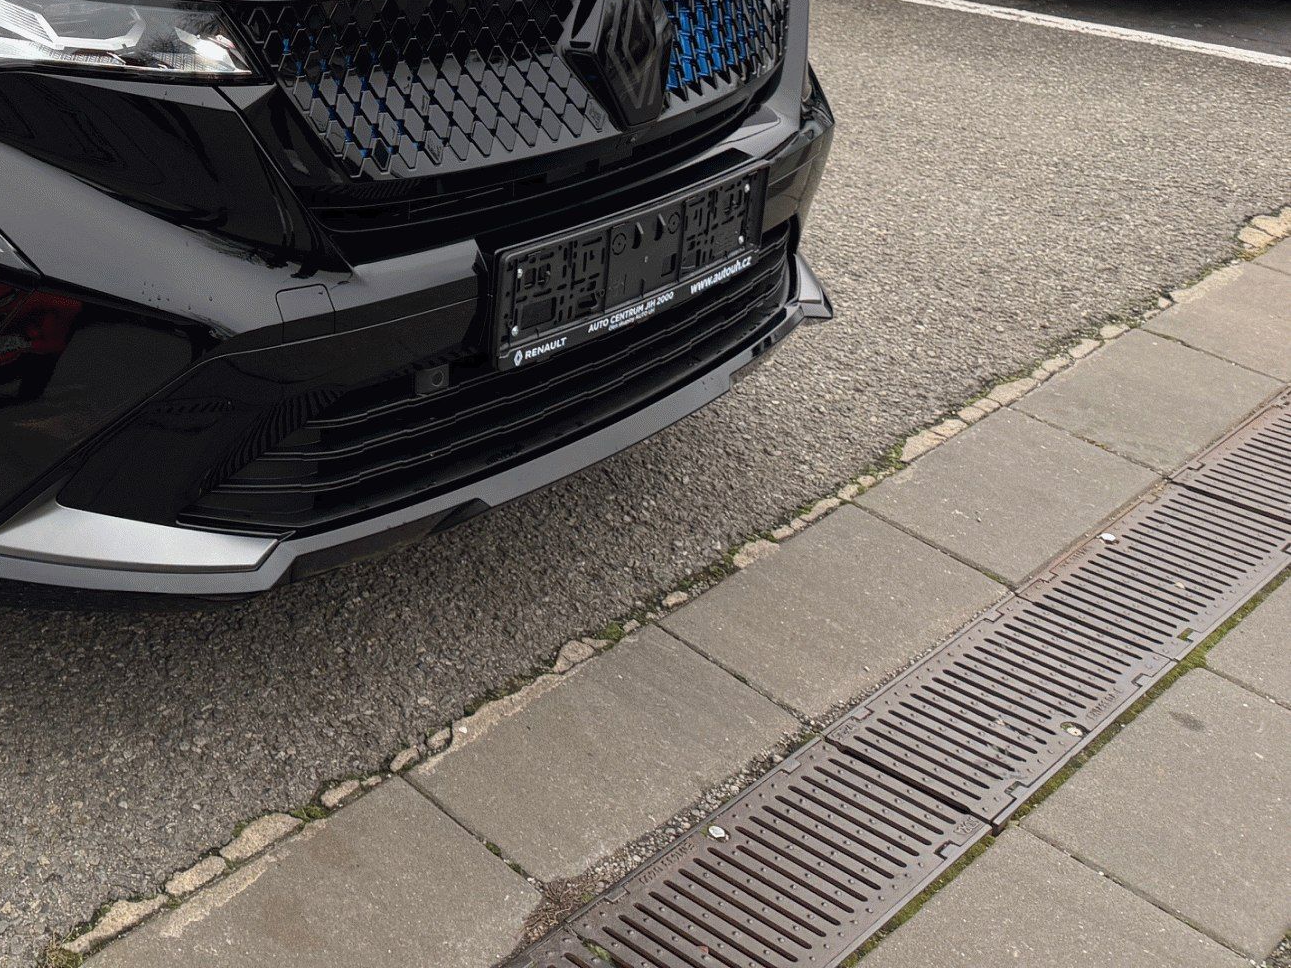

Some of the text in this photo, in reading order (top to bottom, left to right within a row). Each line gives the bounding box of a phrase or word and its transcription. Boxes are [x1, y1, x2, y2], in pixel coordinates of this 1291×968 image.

[690, 255, 753, 295] www.autouh.cz
[588, 319, 609, 333] AUTO
[610, 304, 643, 324] CENTRUM
[656, 291, 674, 305] 2000
[525, 337, 567, 359] RENAULT
